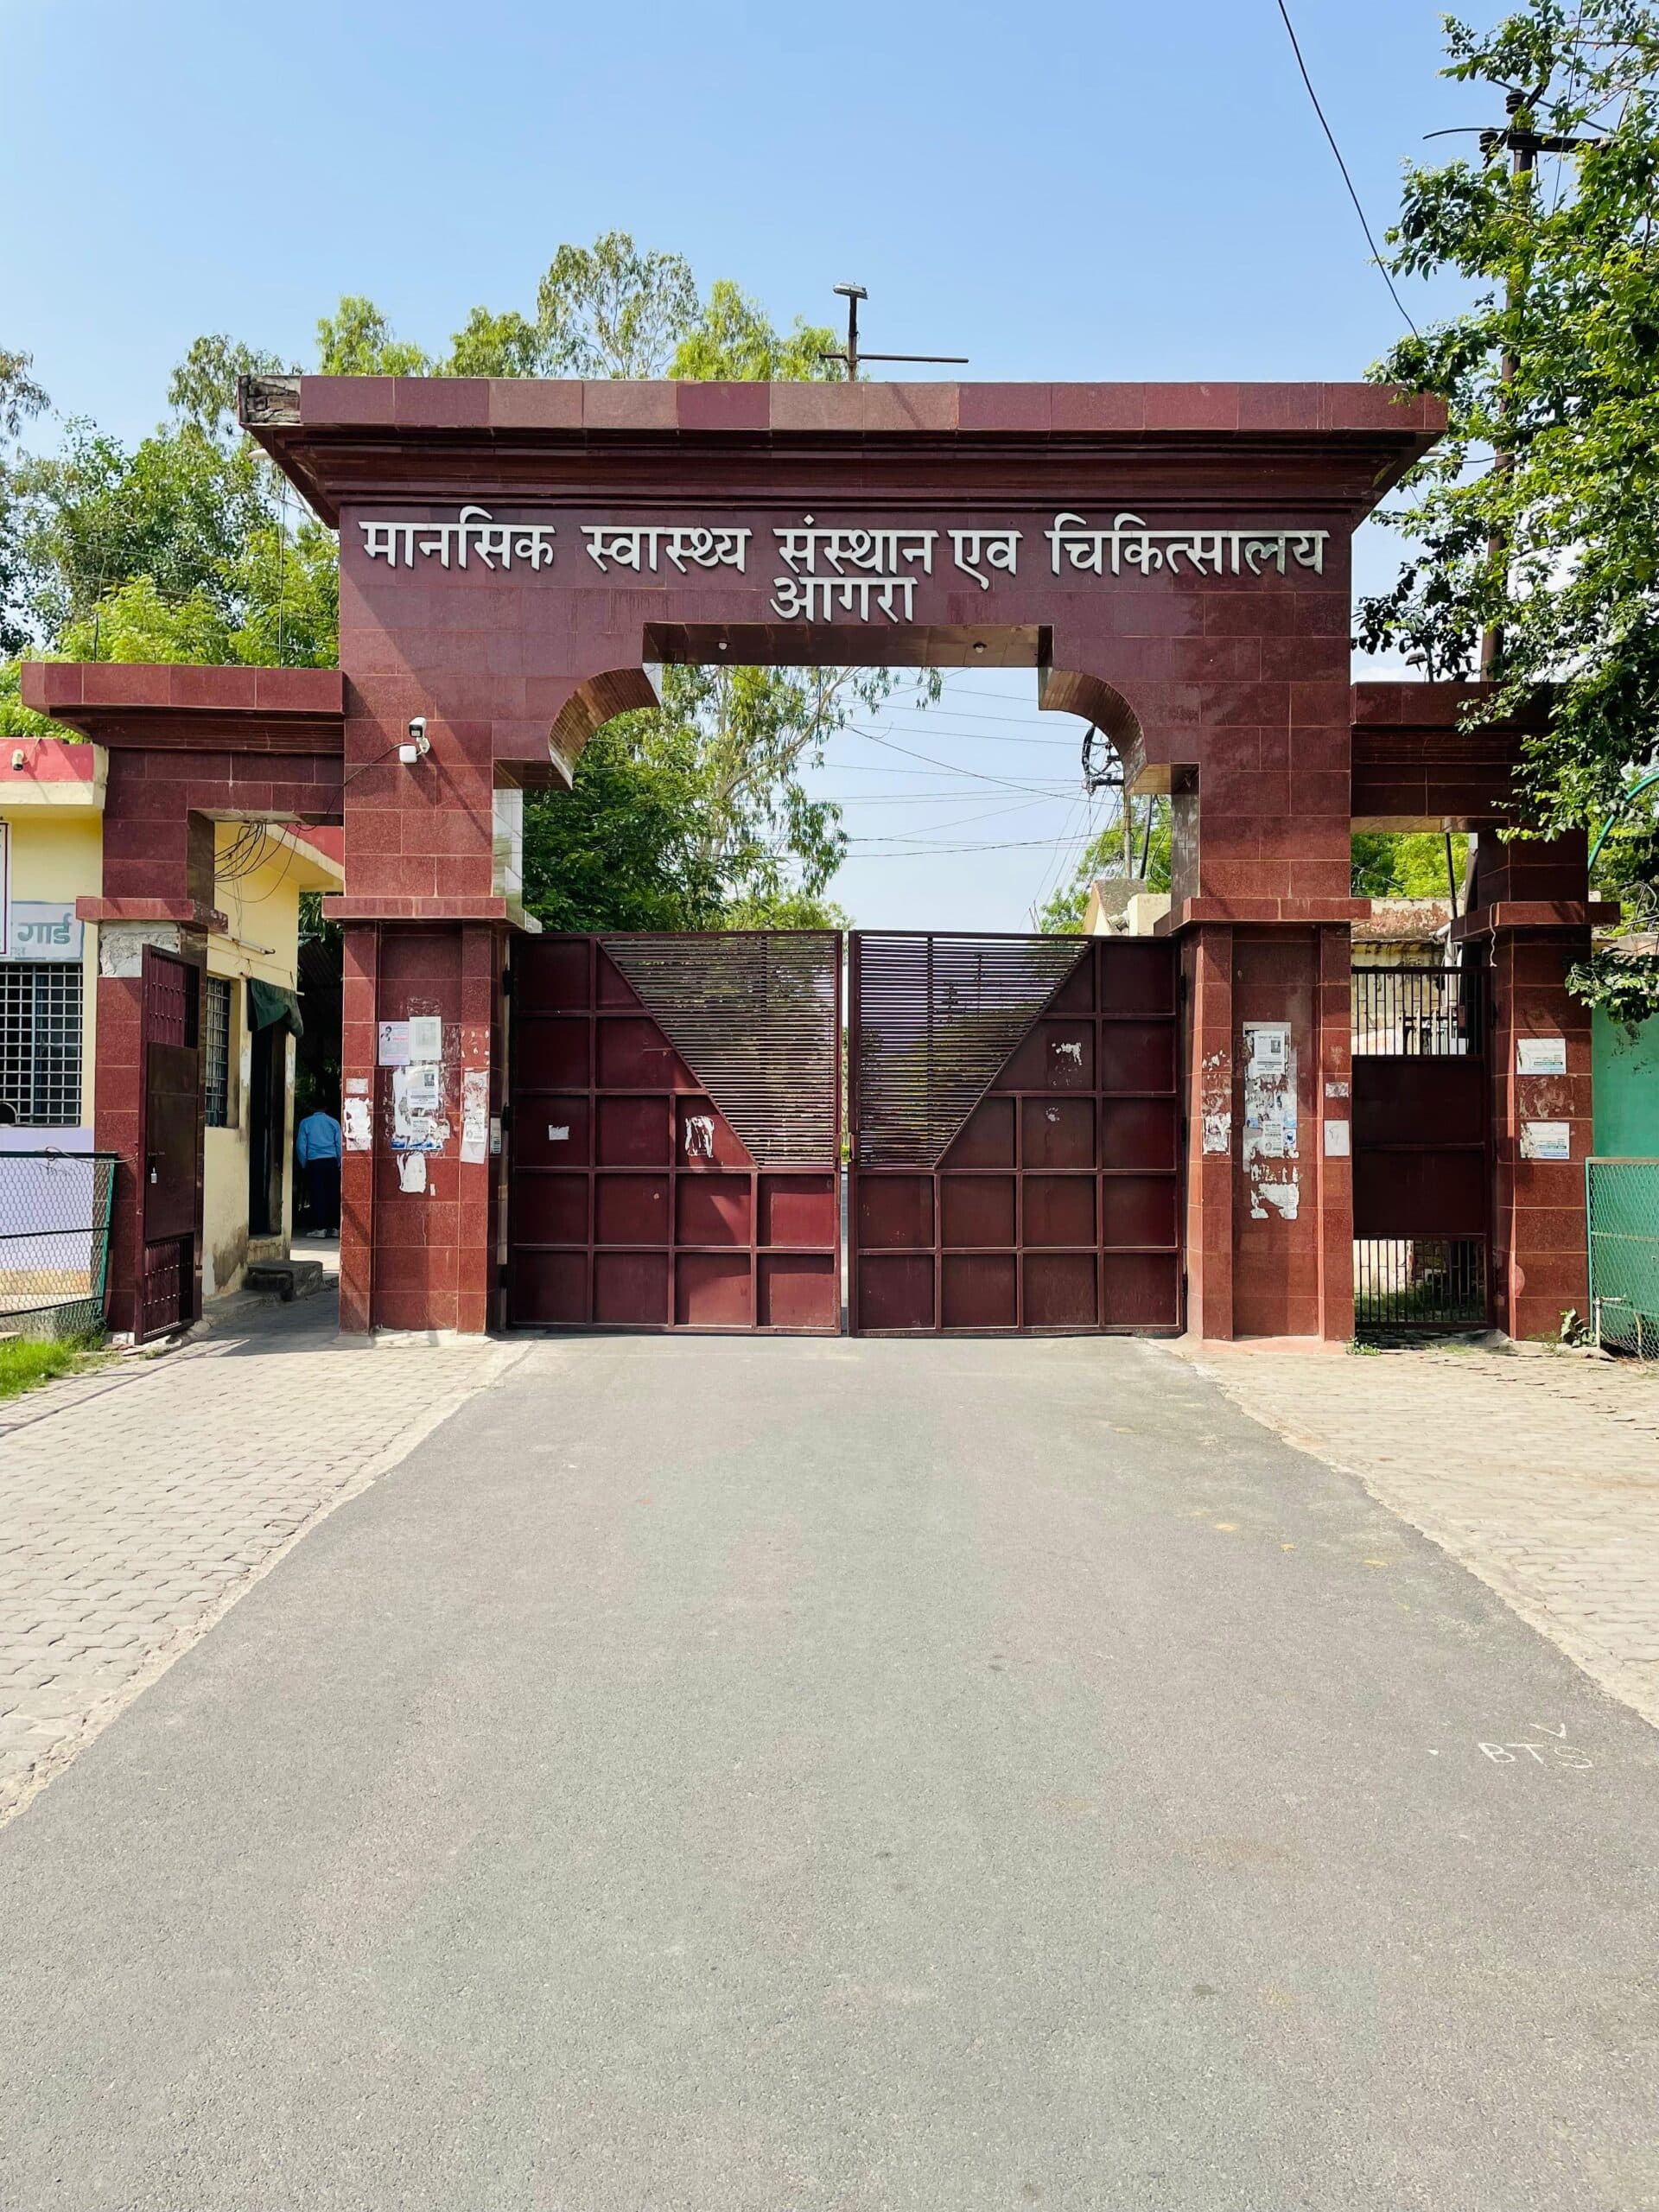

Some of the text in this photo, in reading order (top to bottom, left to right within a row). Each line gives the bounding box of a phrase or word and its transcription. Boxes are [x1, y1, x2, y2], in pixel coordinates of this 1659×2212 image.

[358, 505, 1331, 591] मानसिक स्वास्थ्य संस्थान एव चिकित्सालय
[770, 576, 918, 623] आगरा
[17, 912, 72, 944] गार्ड
[1478, 1742, 1592, 1769] BTS
